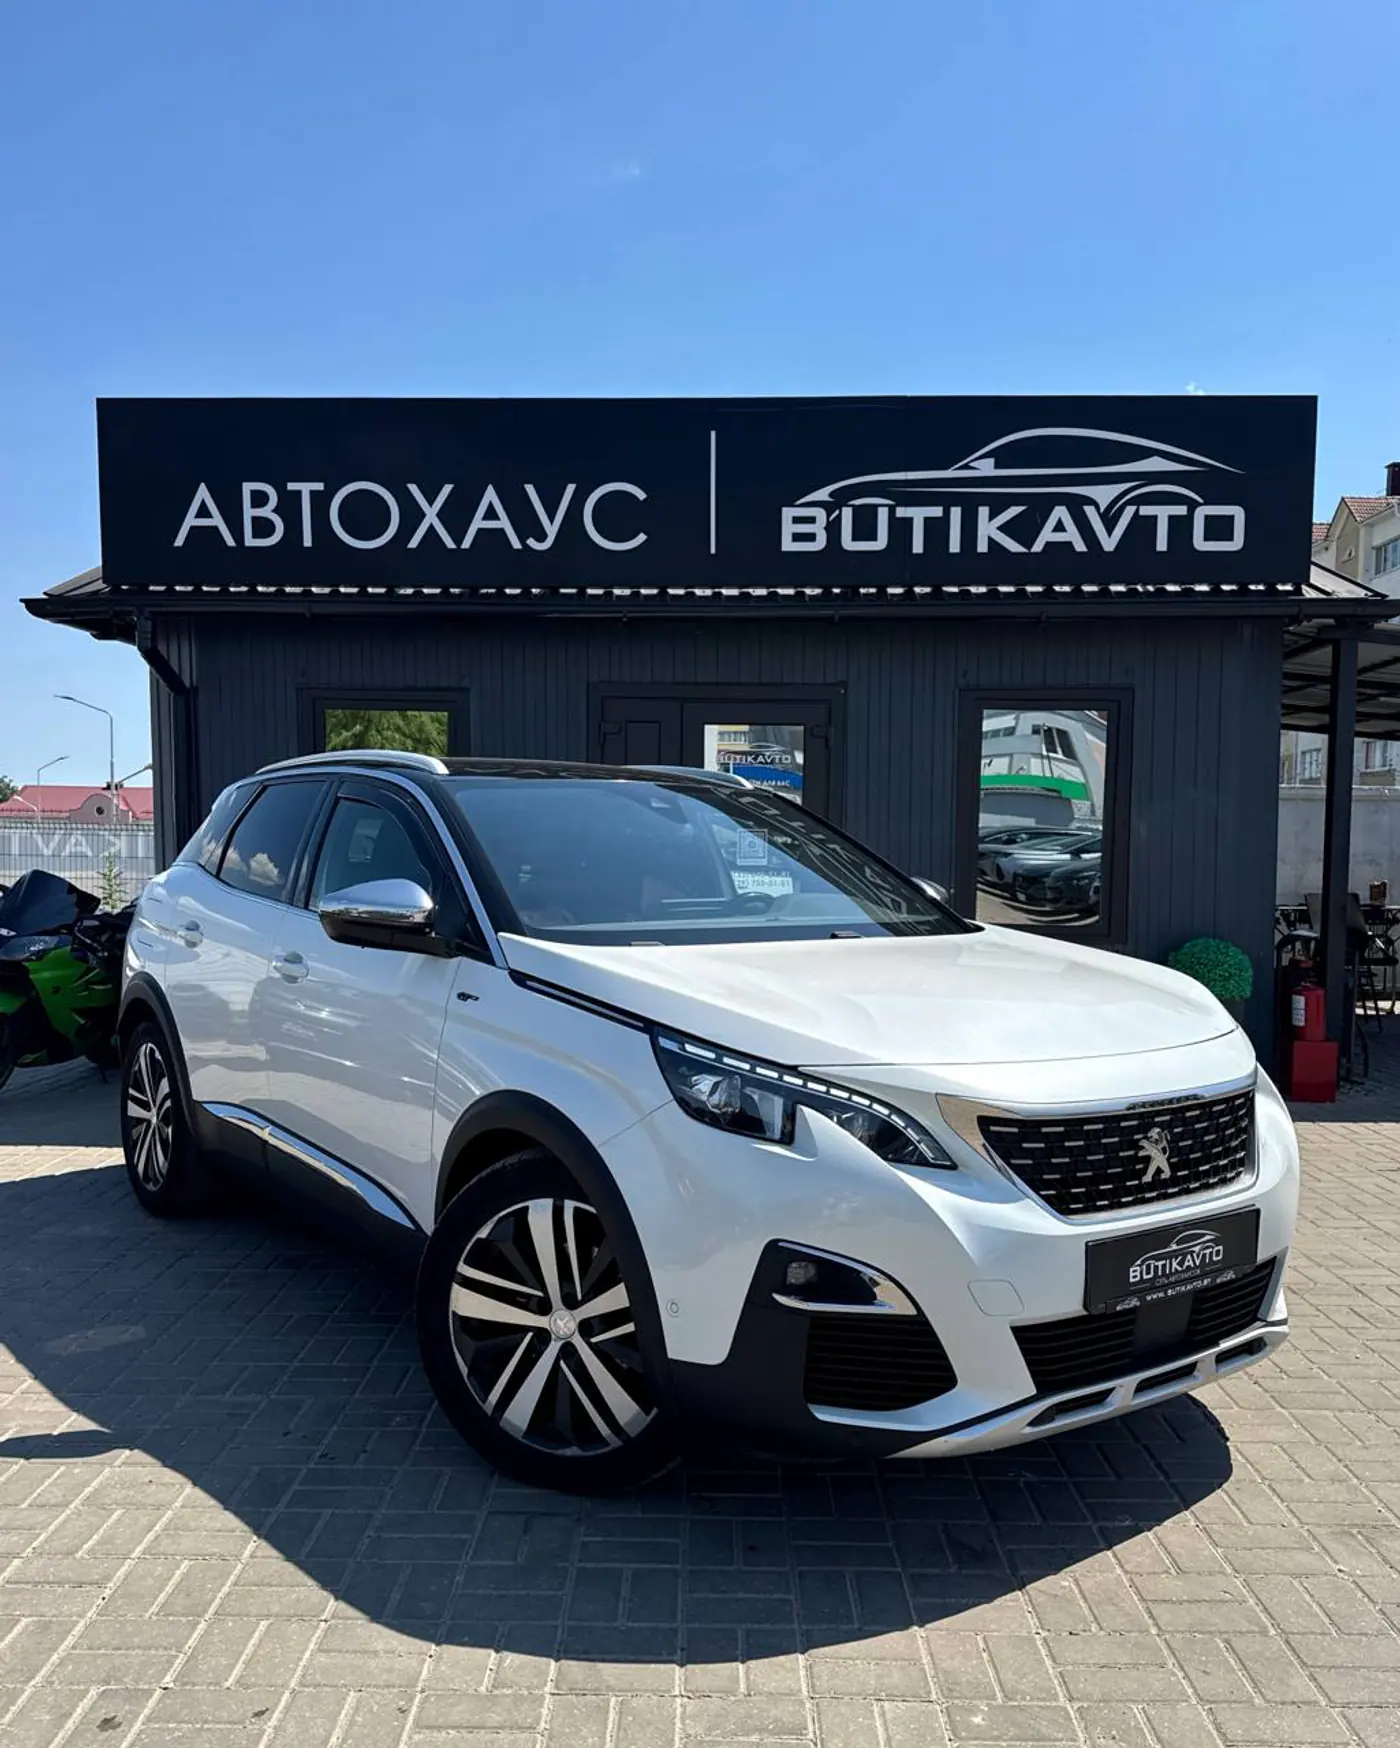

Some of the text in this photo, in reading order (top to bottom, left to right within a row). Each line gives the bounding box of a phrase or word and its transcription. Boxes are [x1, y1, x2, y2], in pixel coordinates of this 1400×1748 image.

[173, 480, 649, 551] АВТОХАУС
[781, 504, 1246, 554] BUTIKAVTO
[1129, 1245, 1224, 1283] BUTIKAVTO
